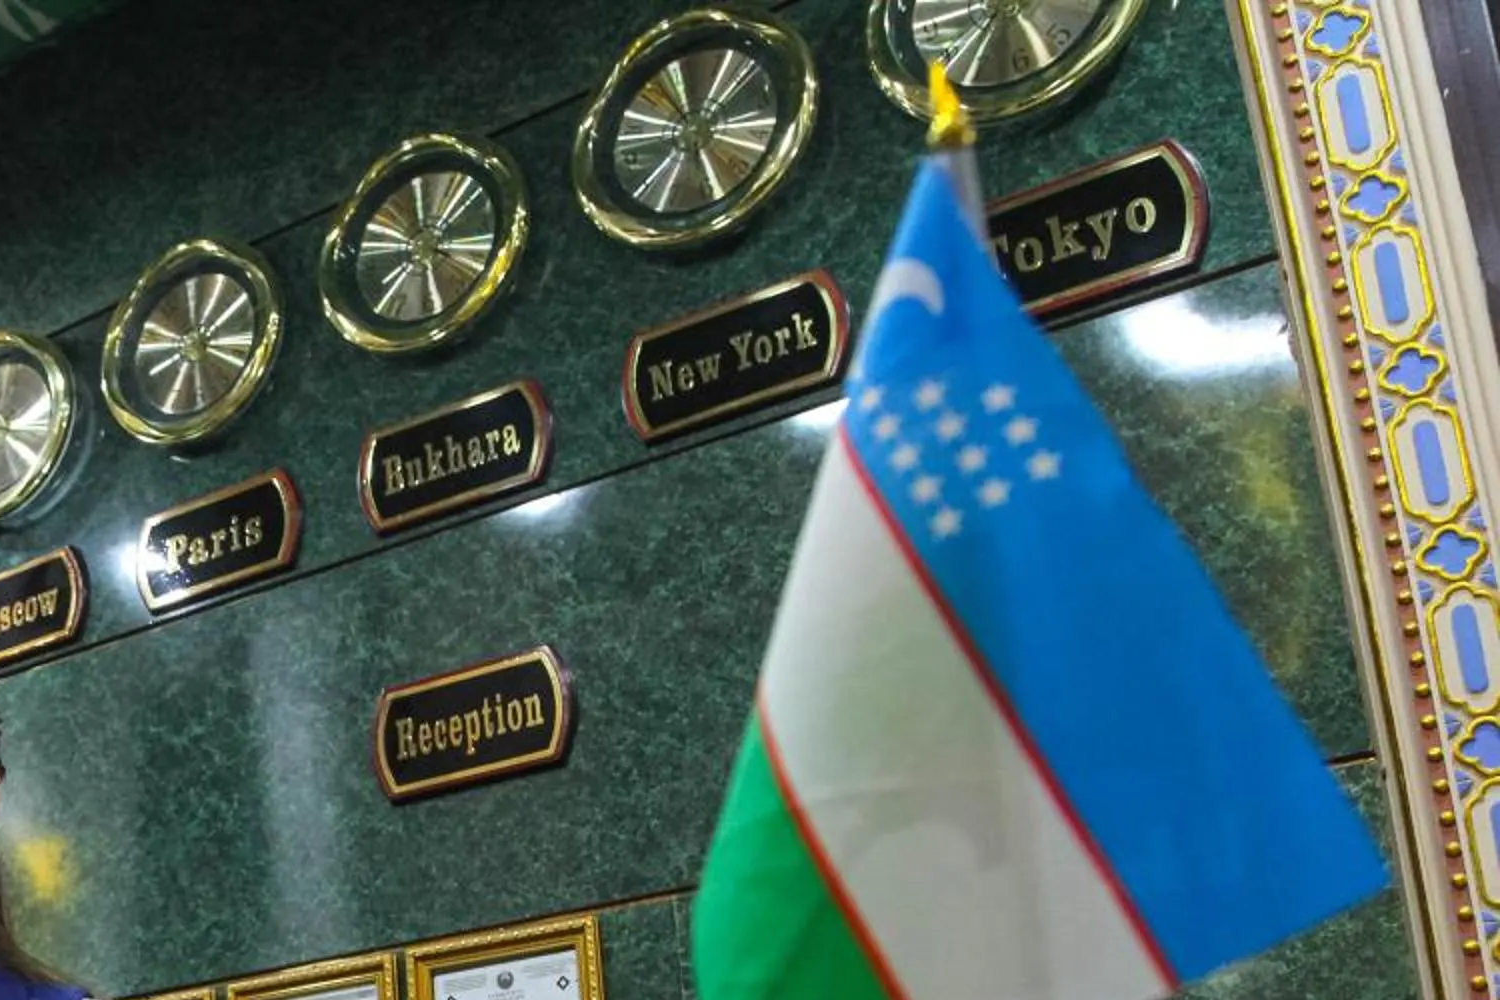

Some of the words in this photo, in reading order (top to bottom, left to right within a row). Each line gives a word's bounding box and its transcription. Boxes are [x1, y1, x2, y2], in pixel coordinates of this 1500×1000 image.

[649, 350, 720, 402] New
[729, 310, 818, 366] York
[382, 422, 522, 496] Bukhara
[164, 513, 264, 572] Paris
[396, 690, 544, 760] Reception
